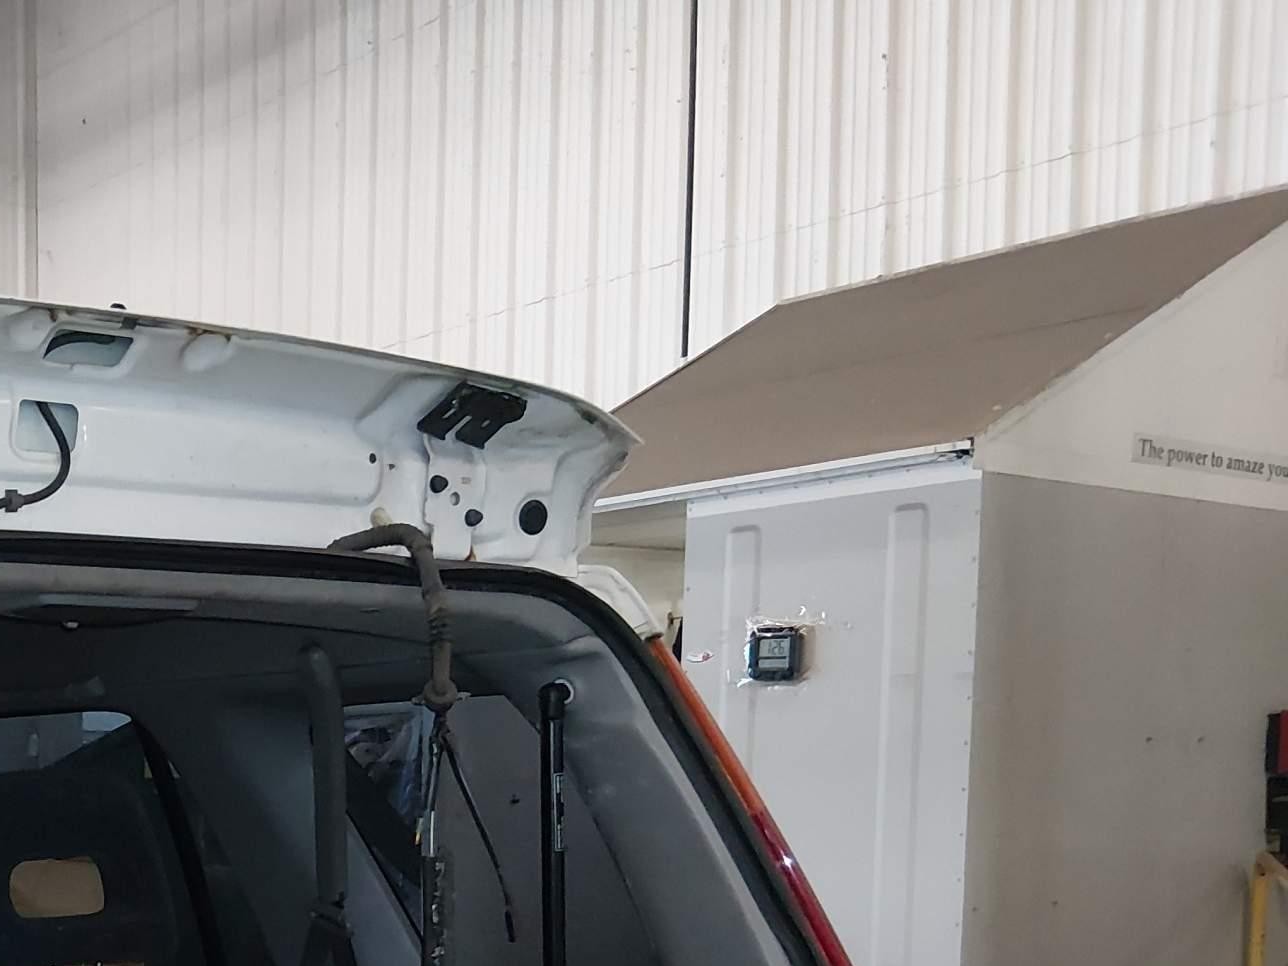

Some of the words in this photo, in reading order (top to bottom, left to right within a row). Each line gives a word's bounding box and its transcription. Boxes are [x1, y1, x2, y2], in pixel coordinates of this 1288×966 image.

[1138, 438, 1164, 460] The
[1165, 448, 1208, 467] power
[1211, 451, 1223, 468] to
[1225, 457, 1264, 474] amaze
